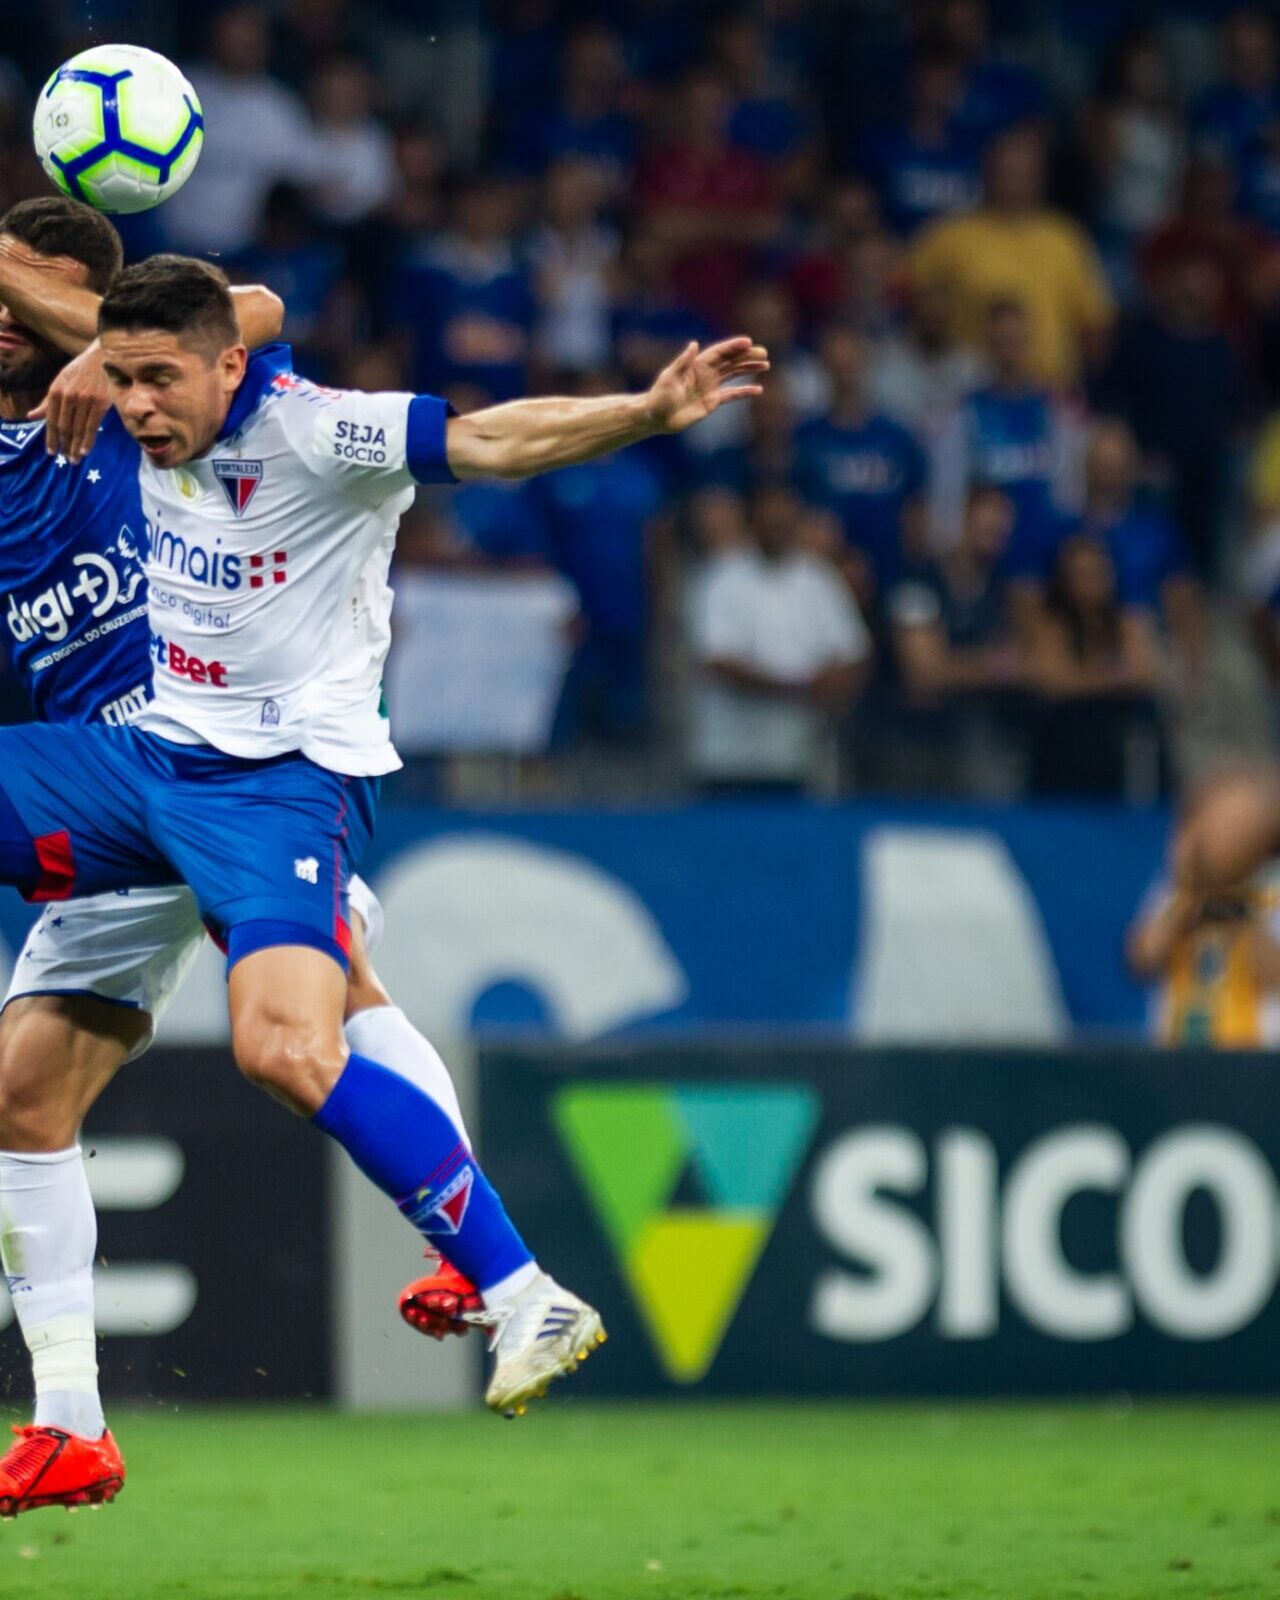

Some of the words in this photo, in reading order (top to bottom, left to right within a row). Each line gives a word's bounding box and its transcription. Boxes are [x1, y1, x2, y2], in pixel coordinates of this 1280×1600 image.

[334, 421, 387, 447] SEJA
[333, 441, 387, 464] SÓCIO
[216, 462, 260, 474] FORTALEZA
[147, 509, 242, 591] imais
[182, 600, 231, 629] digital
[53, 638, 87, 663] DIGITAL
[84, 628, 100, 643] DO
[811, 1121, 1280, 1343] SICO
